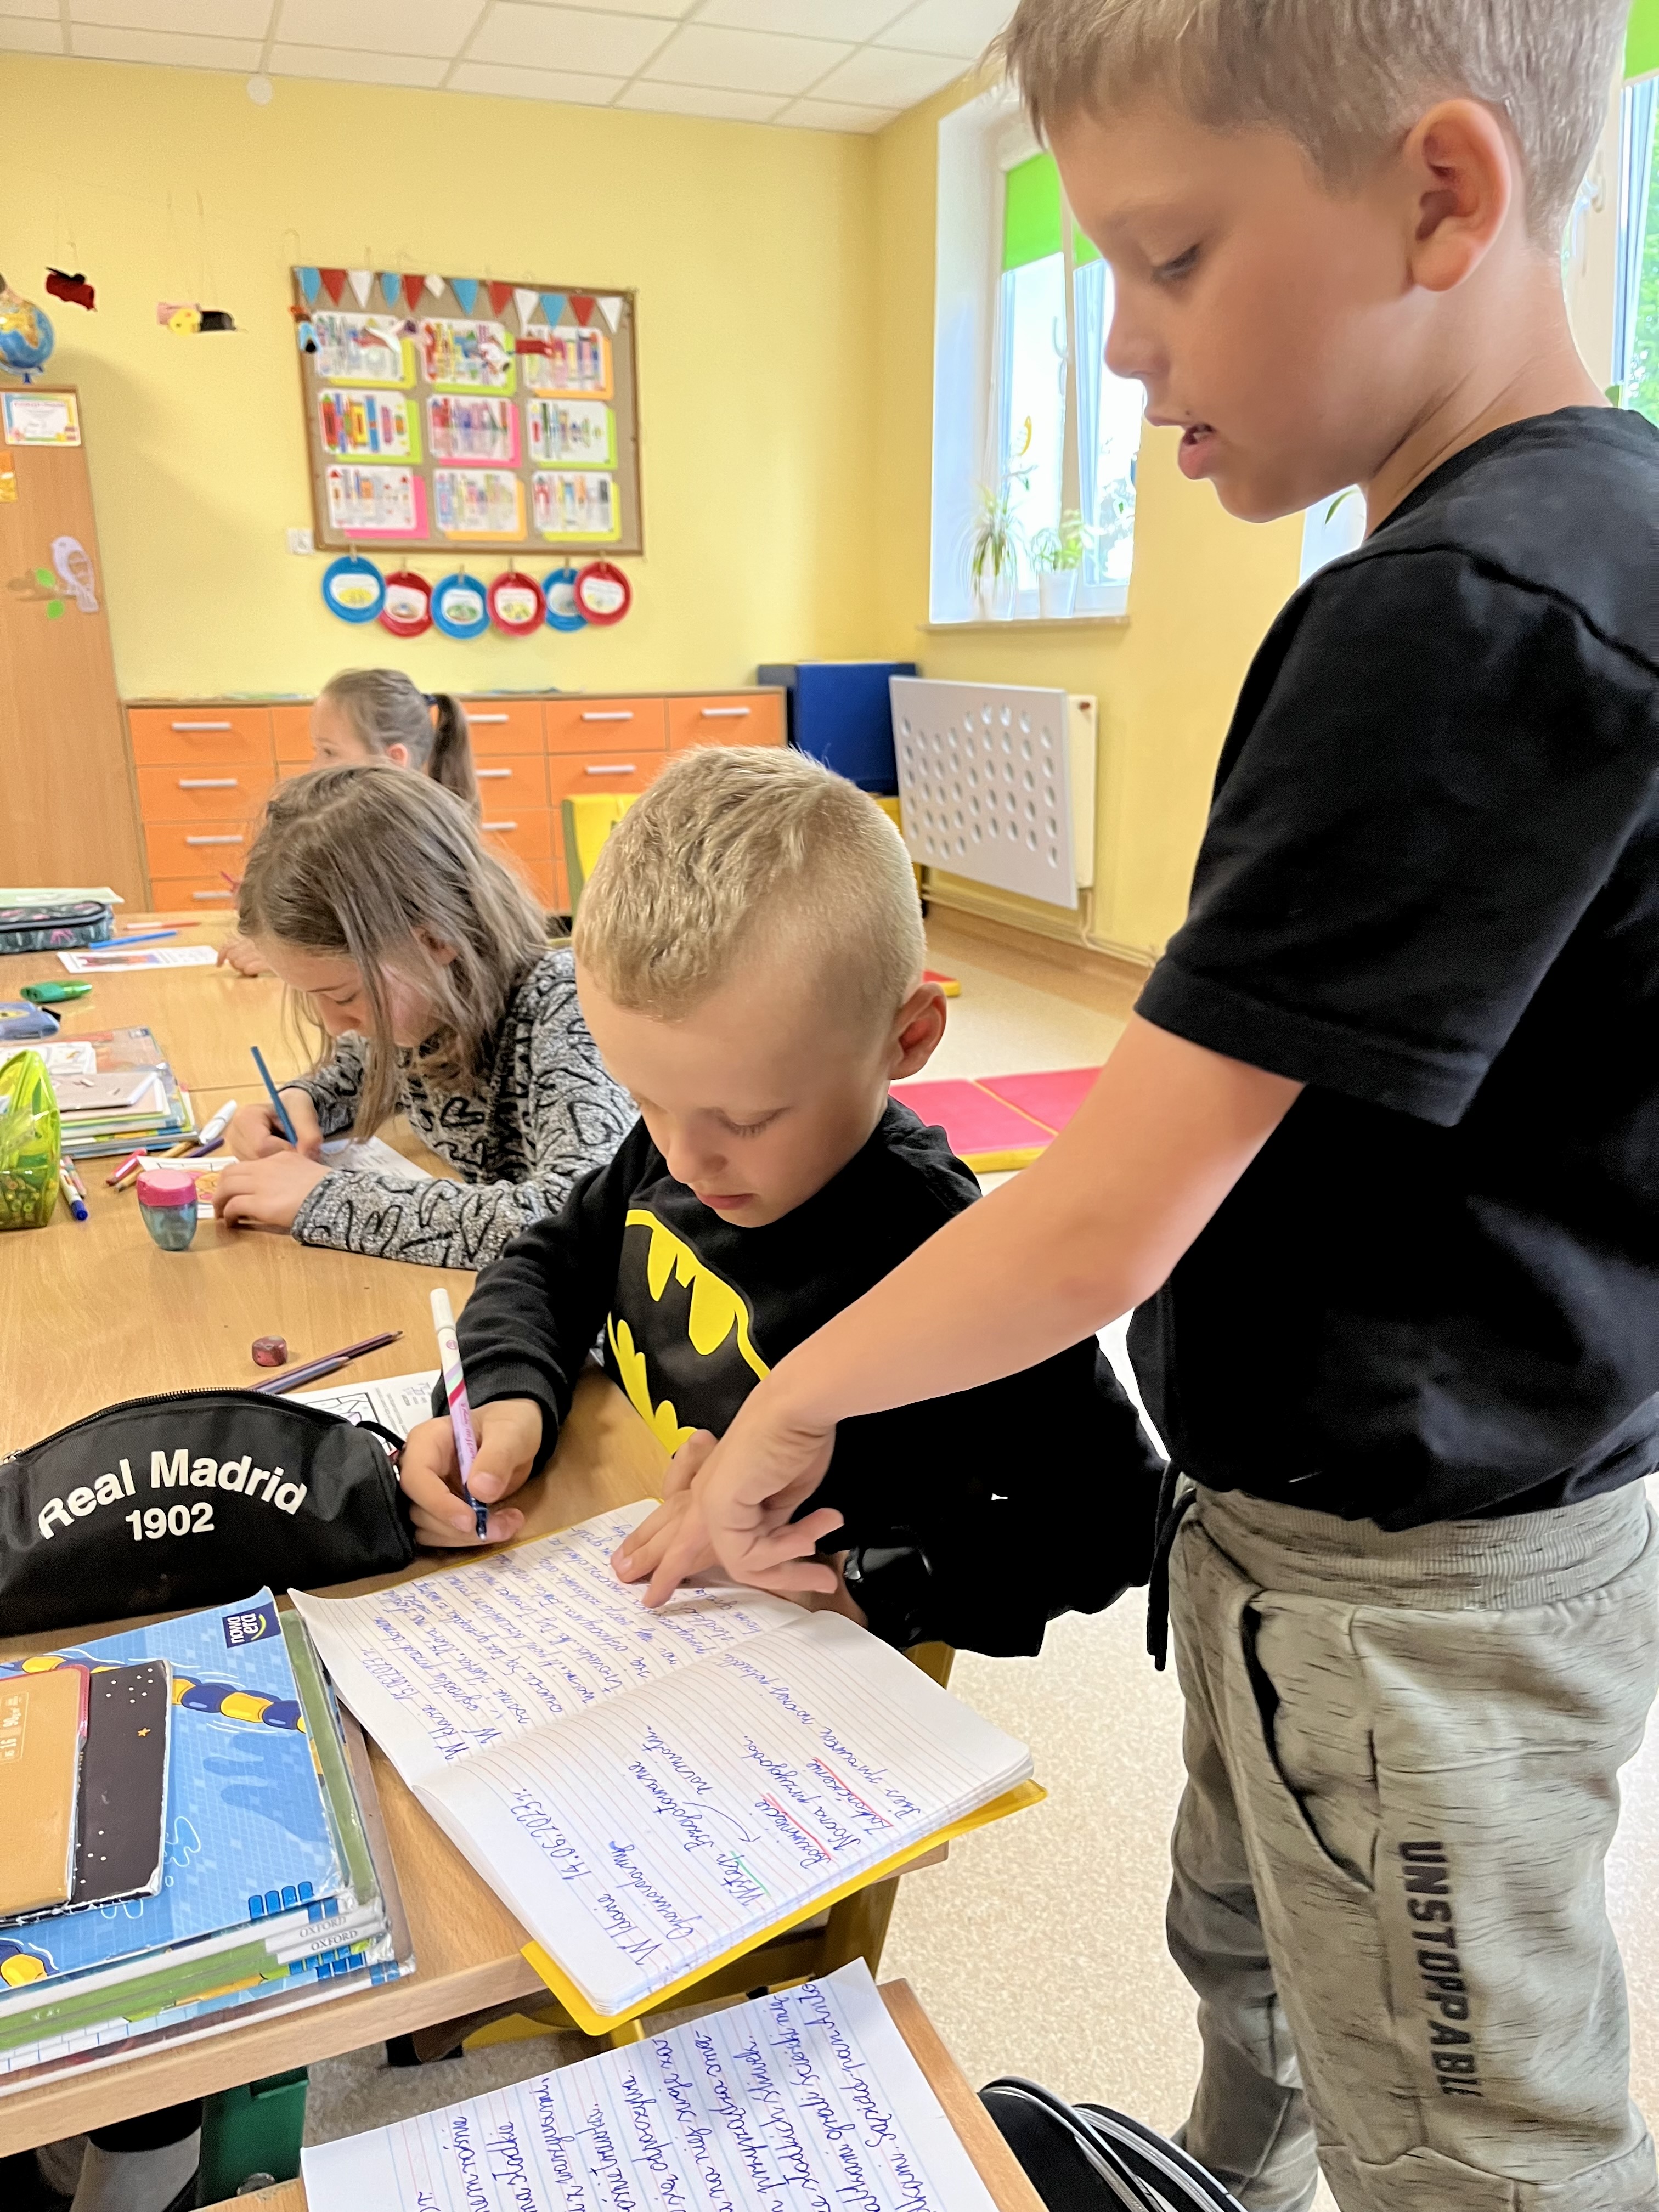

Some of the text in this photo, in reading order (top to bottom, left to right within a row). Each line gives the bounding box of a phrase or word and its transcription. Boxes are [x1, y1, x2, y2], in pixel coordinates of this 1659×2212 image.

[38, 1448, 308, 1539] Real Madrid
[125, 1502, 215, 1541] 1902
[227, 1616, 245, 1644] nowa
[240, 1613, 259, 1634] era
[433, 1741, 470, 1761] W
[300, 1916, 347, 1938] OXFORD
[594, 1894, 636, 1939] klasie
[311, 1930, 358, 1951] OXFORD
[616, 1939, 662, 1966] W
[659, 2073, 696, 2123] swoje
[800, 2091, 855, 2140] grali
[441, 2116, 475, 2172] rośnie
[486, 2121, 528, 2185] słodkie
[759, 2107, 820, 2191] słodkich
[704, 2166, 725, 2198] na
